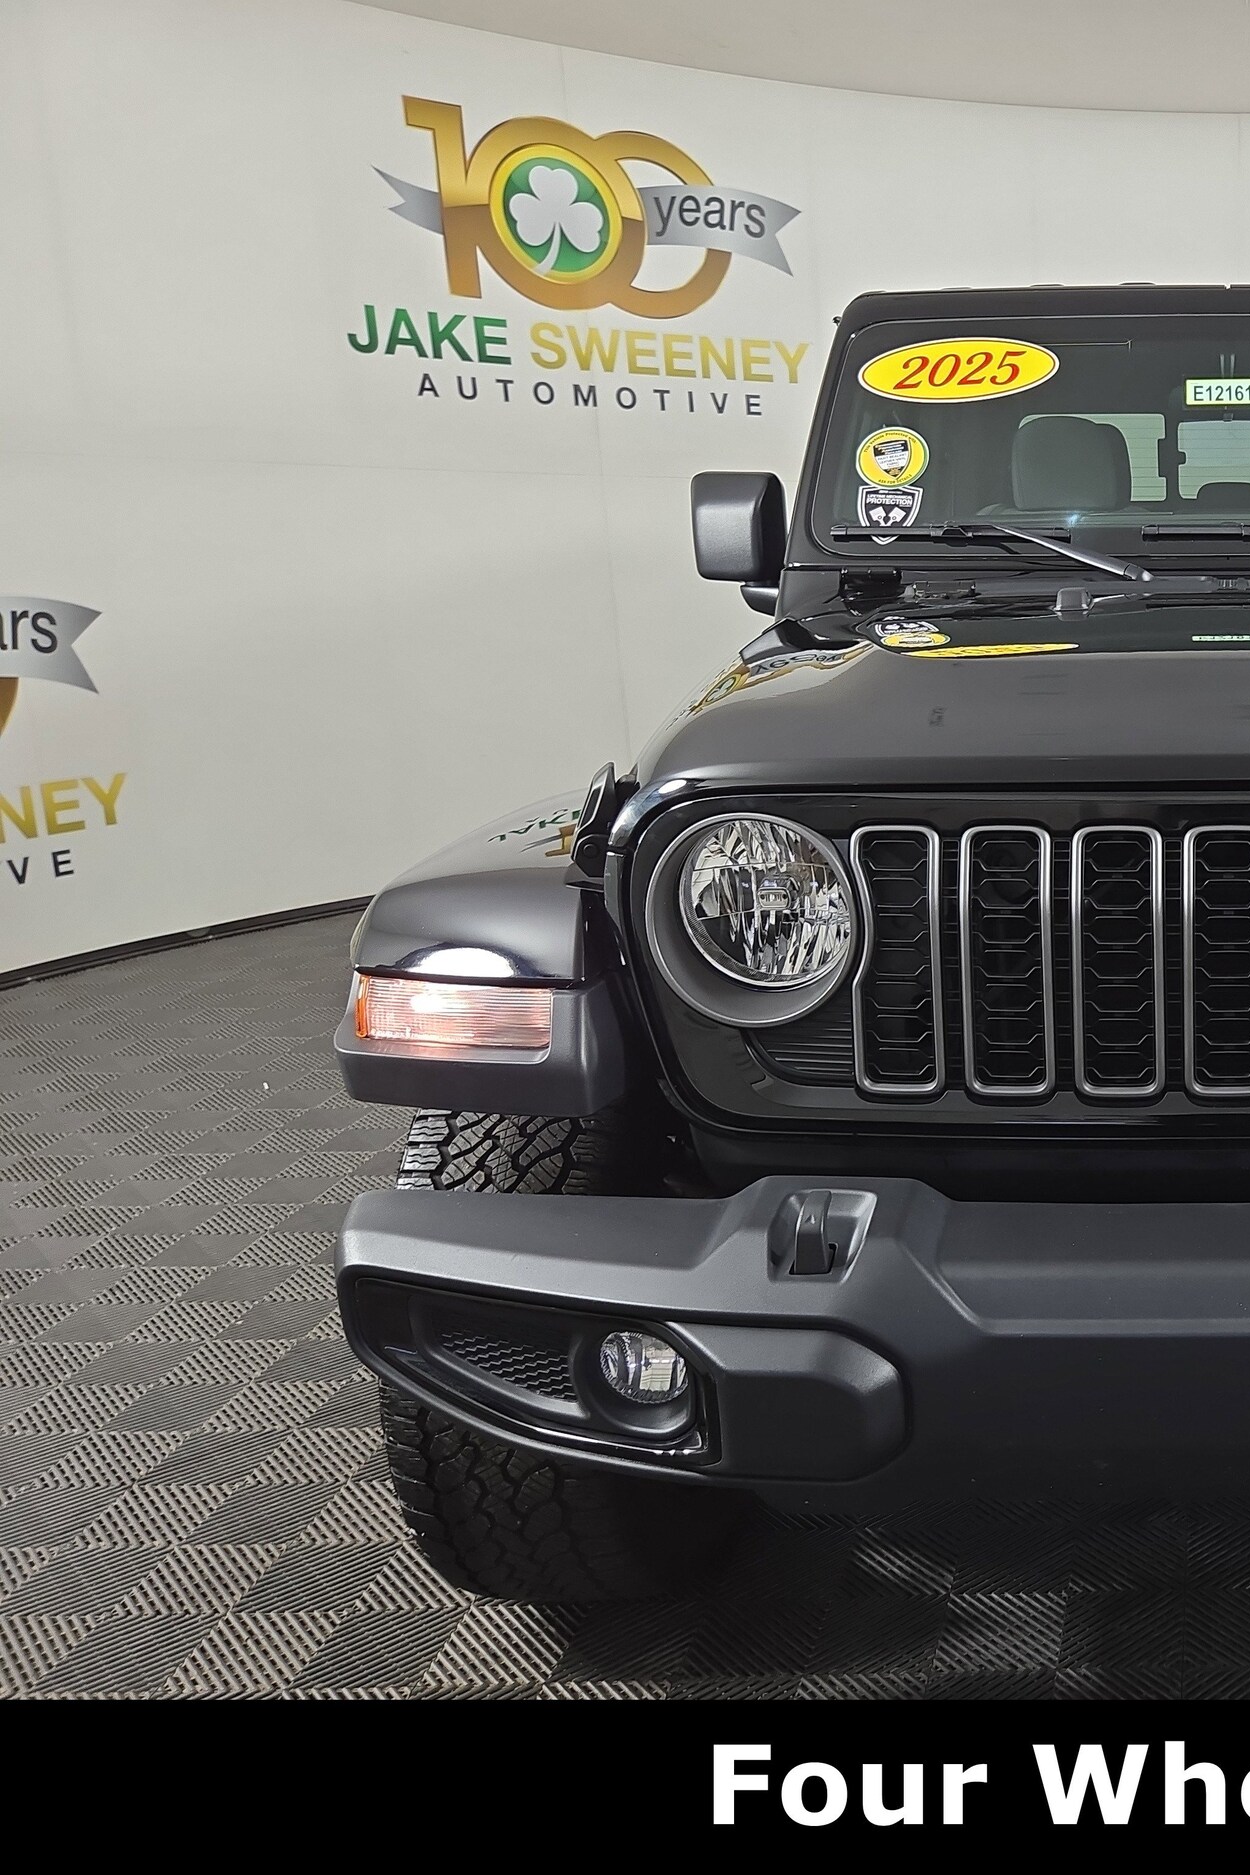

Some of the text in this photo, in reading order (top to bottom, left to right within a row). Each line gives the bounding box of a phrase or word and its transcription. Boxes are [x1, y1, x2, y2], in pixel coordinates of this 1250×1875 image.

[653, 193, 767, 239] years
[348, 304, 810, 384] JAKE SWEENEY
[893, 351, 1027, 390] 2025
[417, 373, 763, 416] AUTOMOTIVE
